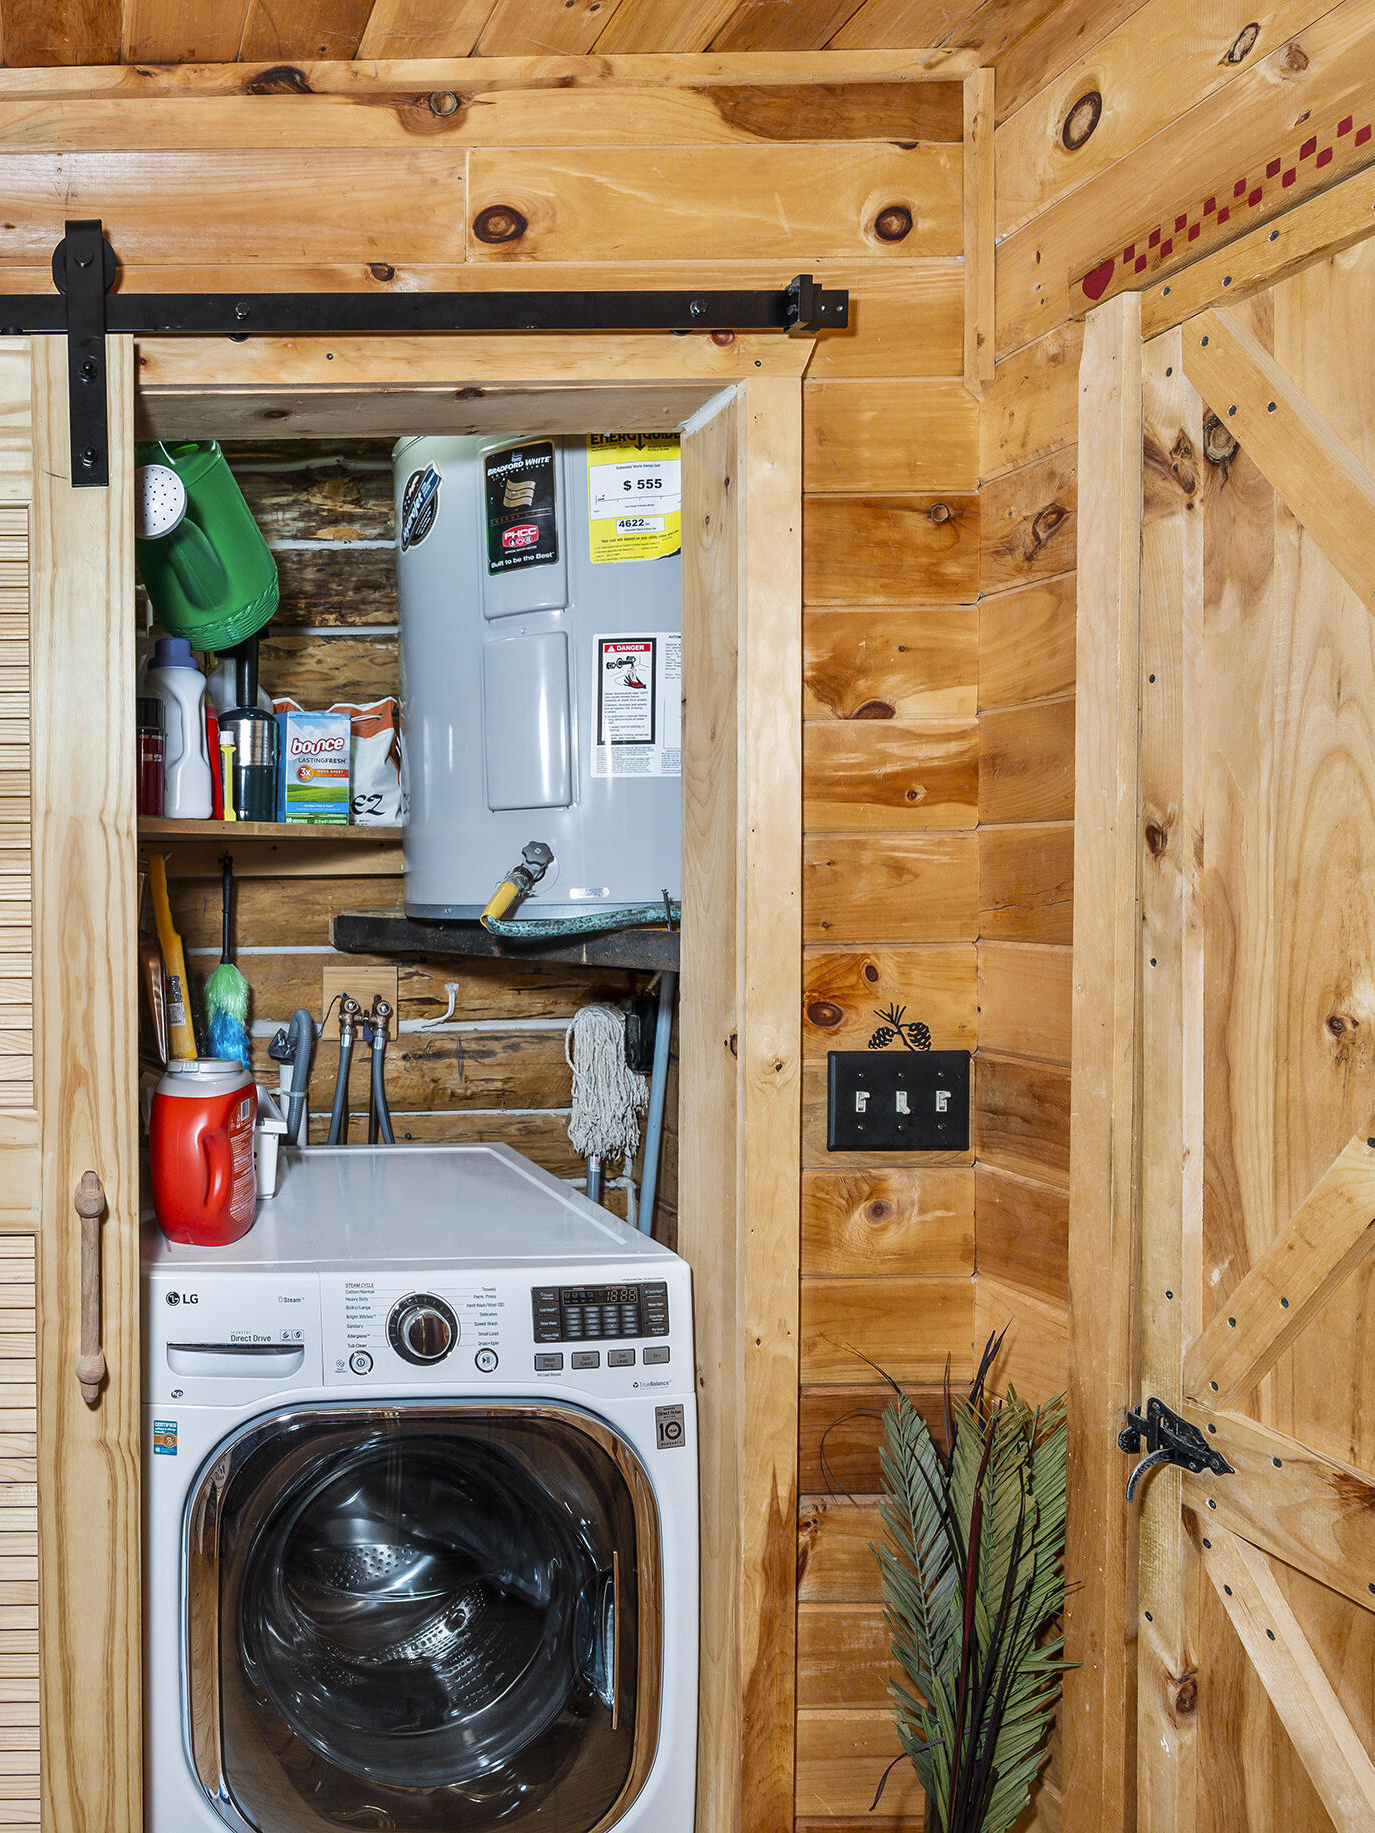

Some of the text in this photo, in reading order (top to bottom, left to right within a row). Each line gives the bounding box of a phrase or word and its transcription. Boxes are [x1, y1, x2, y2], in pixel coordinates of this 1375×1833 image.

[487, 456, 552, 477] BRADFORD WHITE
[637, 479, 662, 489] 555
[618, 519, 645, 528] 4622
[504, 527, 537, 540] PHCC
[291, 737, 345, 755] bounce
[300, 767, 311, 776] 3x
[182, 1294, 198, 1304] LG
[659, 1421, 681, 1441] 10
